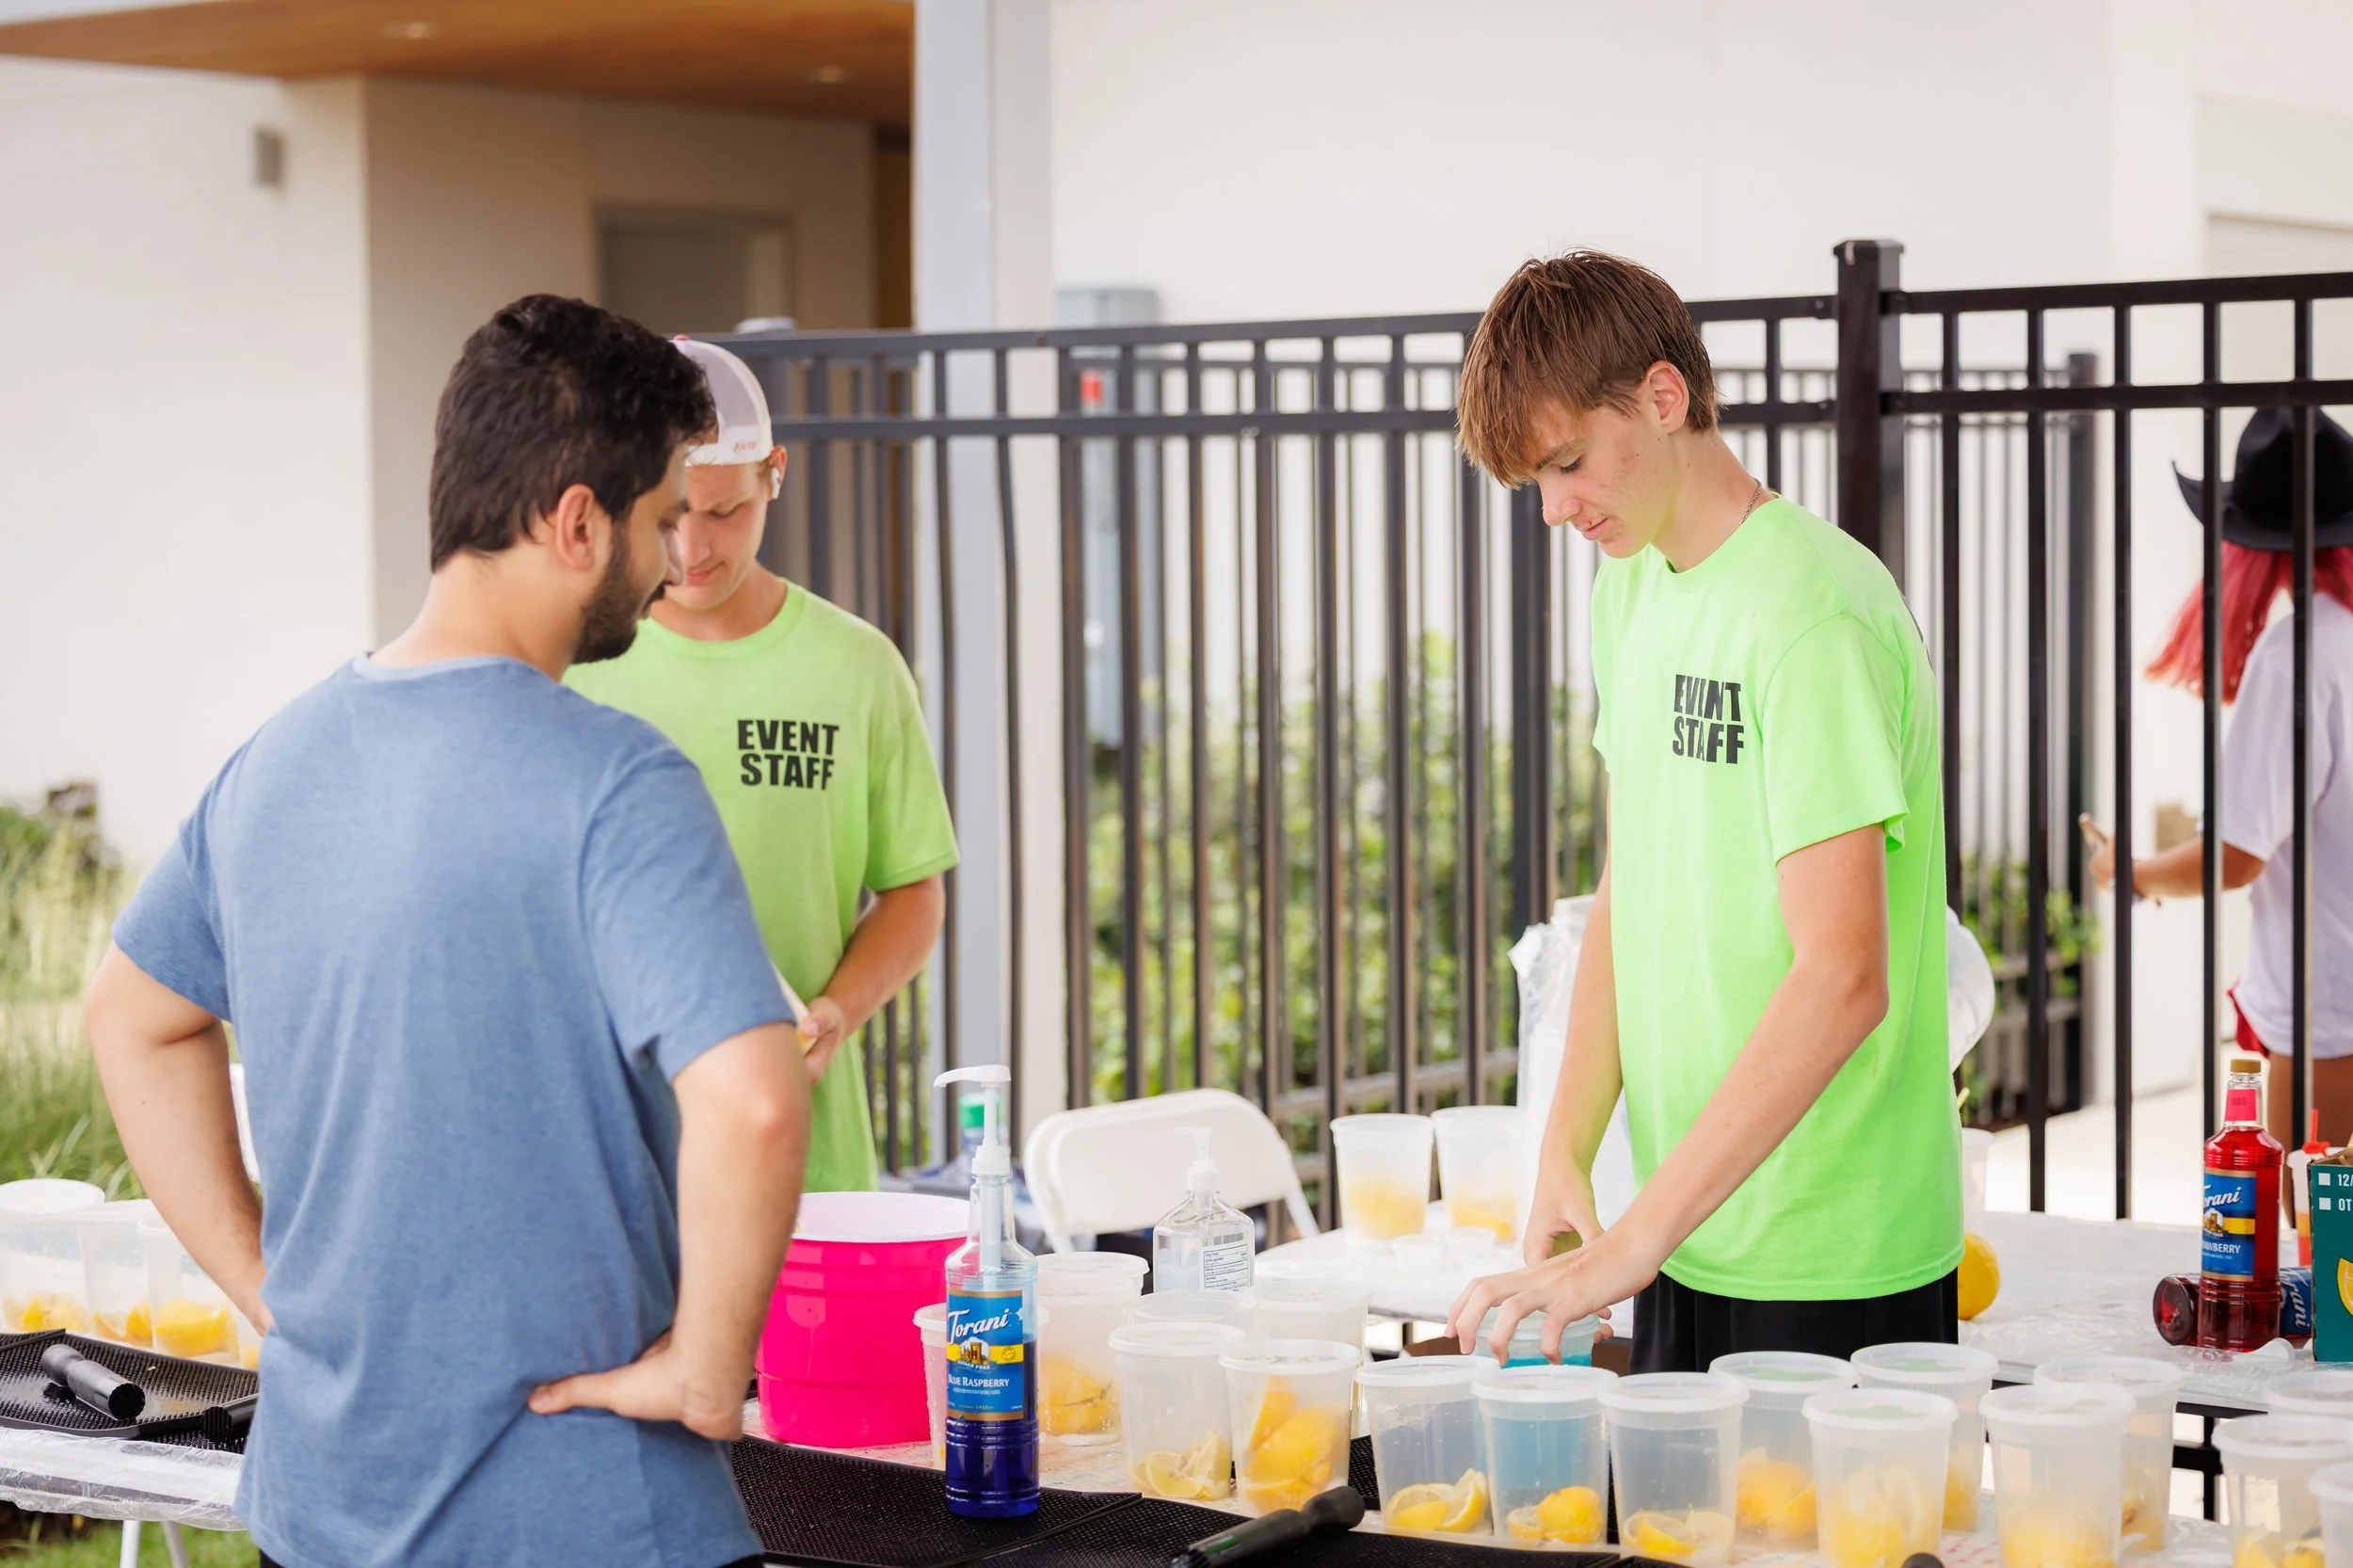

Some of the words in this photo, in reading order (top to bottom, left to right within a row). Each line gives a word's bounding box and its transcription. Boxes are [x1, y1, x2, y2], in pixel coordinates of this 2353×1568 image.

[738, 720, 840, 755] EVENT
[1673, 715, 1744, 764] STAFF
[741, 753, 834, 791] STAFF
[2203, 1185, 2242, 1208] rani
[948, 1308, 1010, 1344] Torani
[962, 1376, 1010, 1387] RASPBERRY
